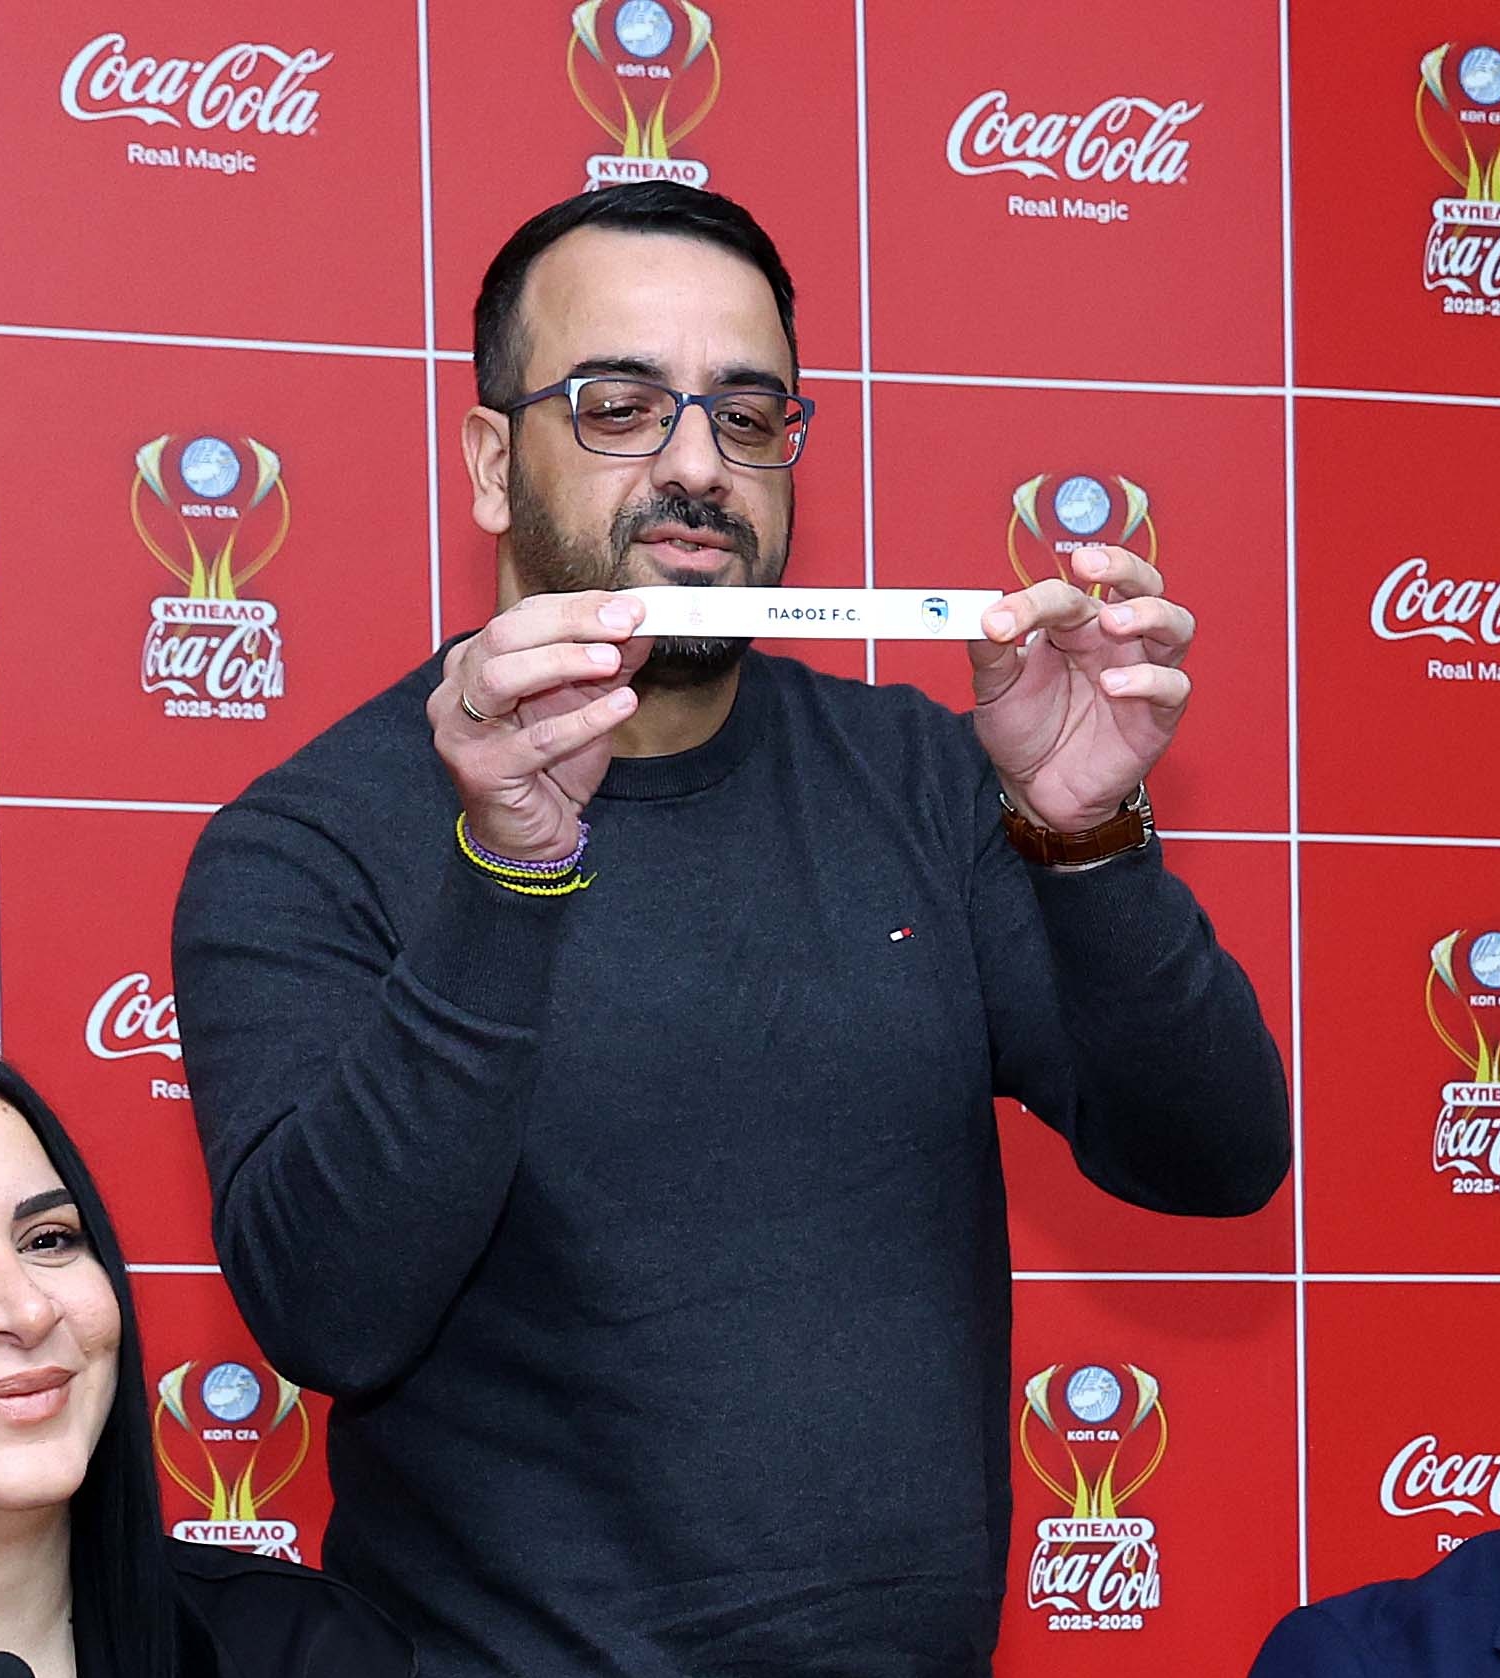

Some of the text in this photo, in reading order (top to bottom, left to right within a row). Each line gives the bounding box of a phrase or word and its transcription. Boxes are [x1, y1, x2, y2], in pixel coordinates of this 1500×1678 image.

[60, 32, 333, 135] Coca-Cola
[946, 90, 1203, 184] Coca-Cola
[127, 143, 256, 174] Real Magic
[598, 160, 695, 180] ΚΥΠΕΛΛΟ
[1008, 195, 1128, 223] Real Magic
[162, 602, 264, 621] ΚΥΠΕΛΛΟ
[767, 606, 861, 622] ΠΑΦΟΣ F.C.
[1427, 659, 1473, 679] Real
[164, 699, 266, 719] 2025-2026
[151, 1079, 192, 1100] Rea
[184, 1524, 284, 1540] ΚΥΠΕΛΛΟ
[1048, 1522, 1142, 1537] ΚΥΠΕΛΛΟ
[1048, 1613, 1143, 1630] 2025-2026
